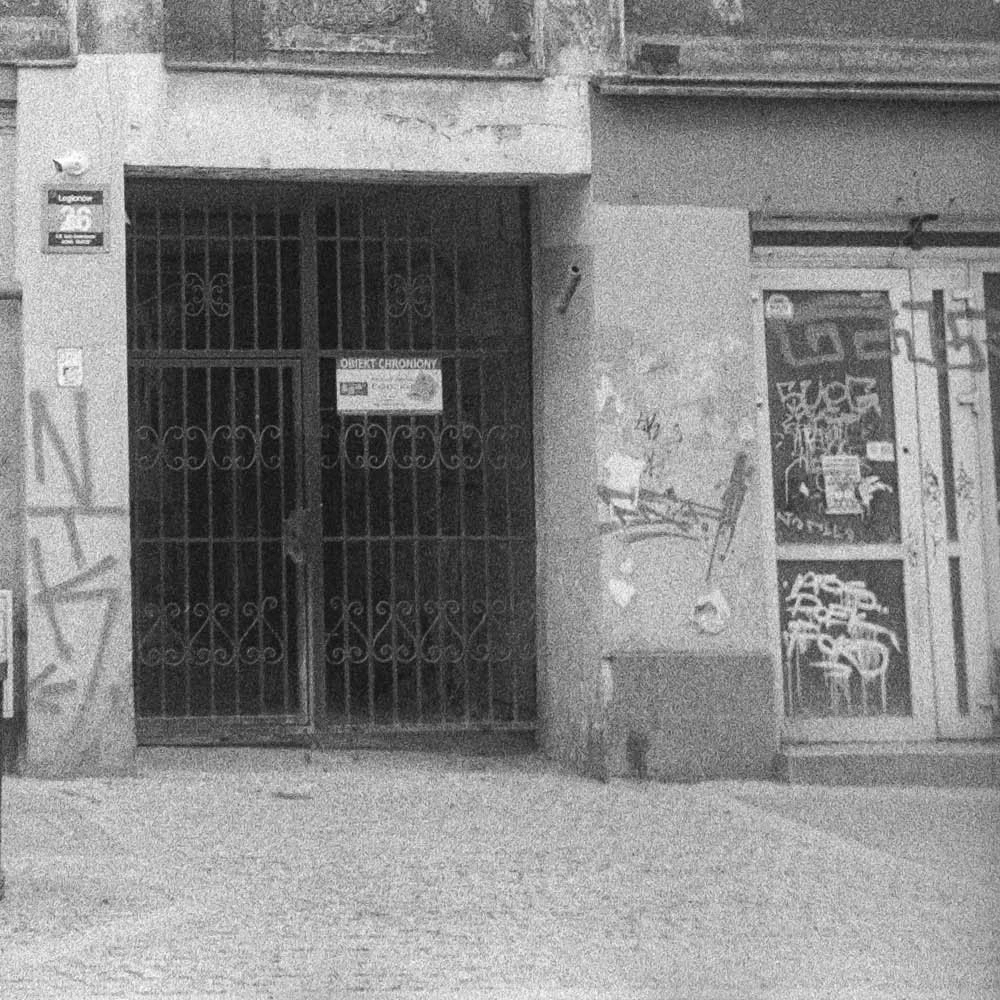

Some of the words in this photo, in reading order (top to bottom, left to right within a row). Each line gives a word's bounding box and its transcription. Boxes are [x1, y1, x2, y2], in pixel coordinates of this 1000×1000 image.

[60, 205, 92, 232] 26
[340, 358, 376, 369] OBIEKT
[378, 358, 438, 369] CHRONIONY
